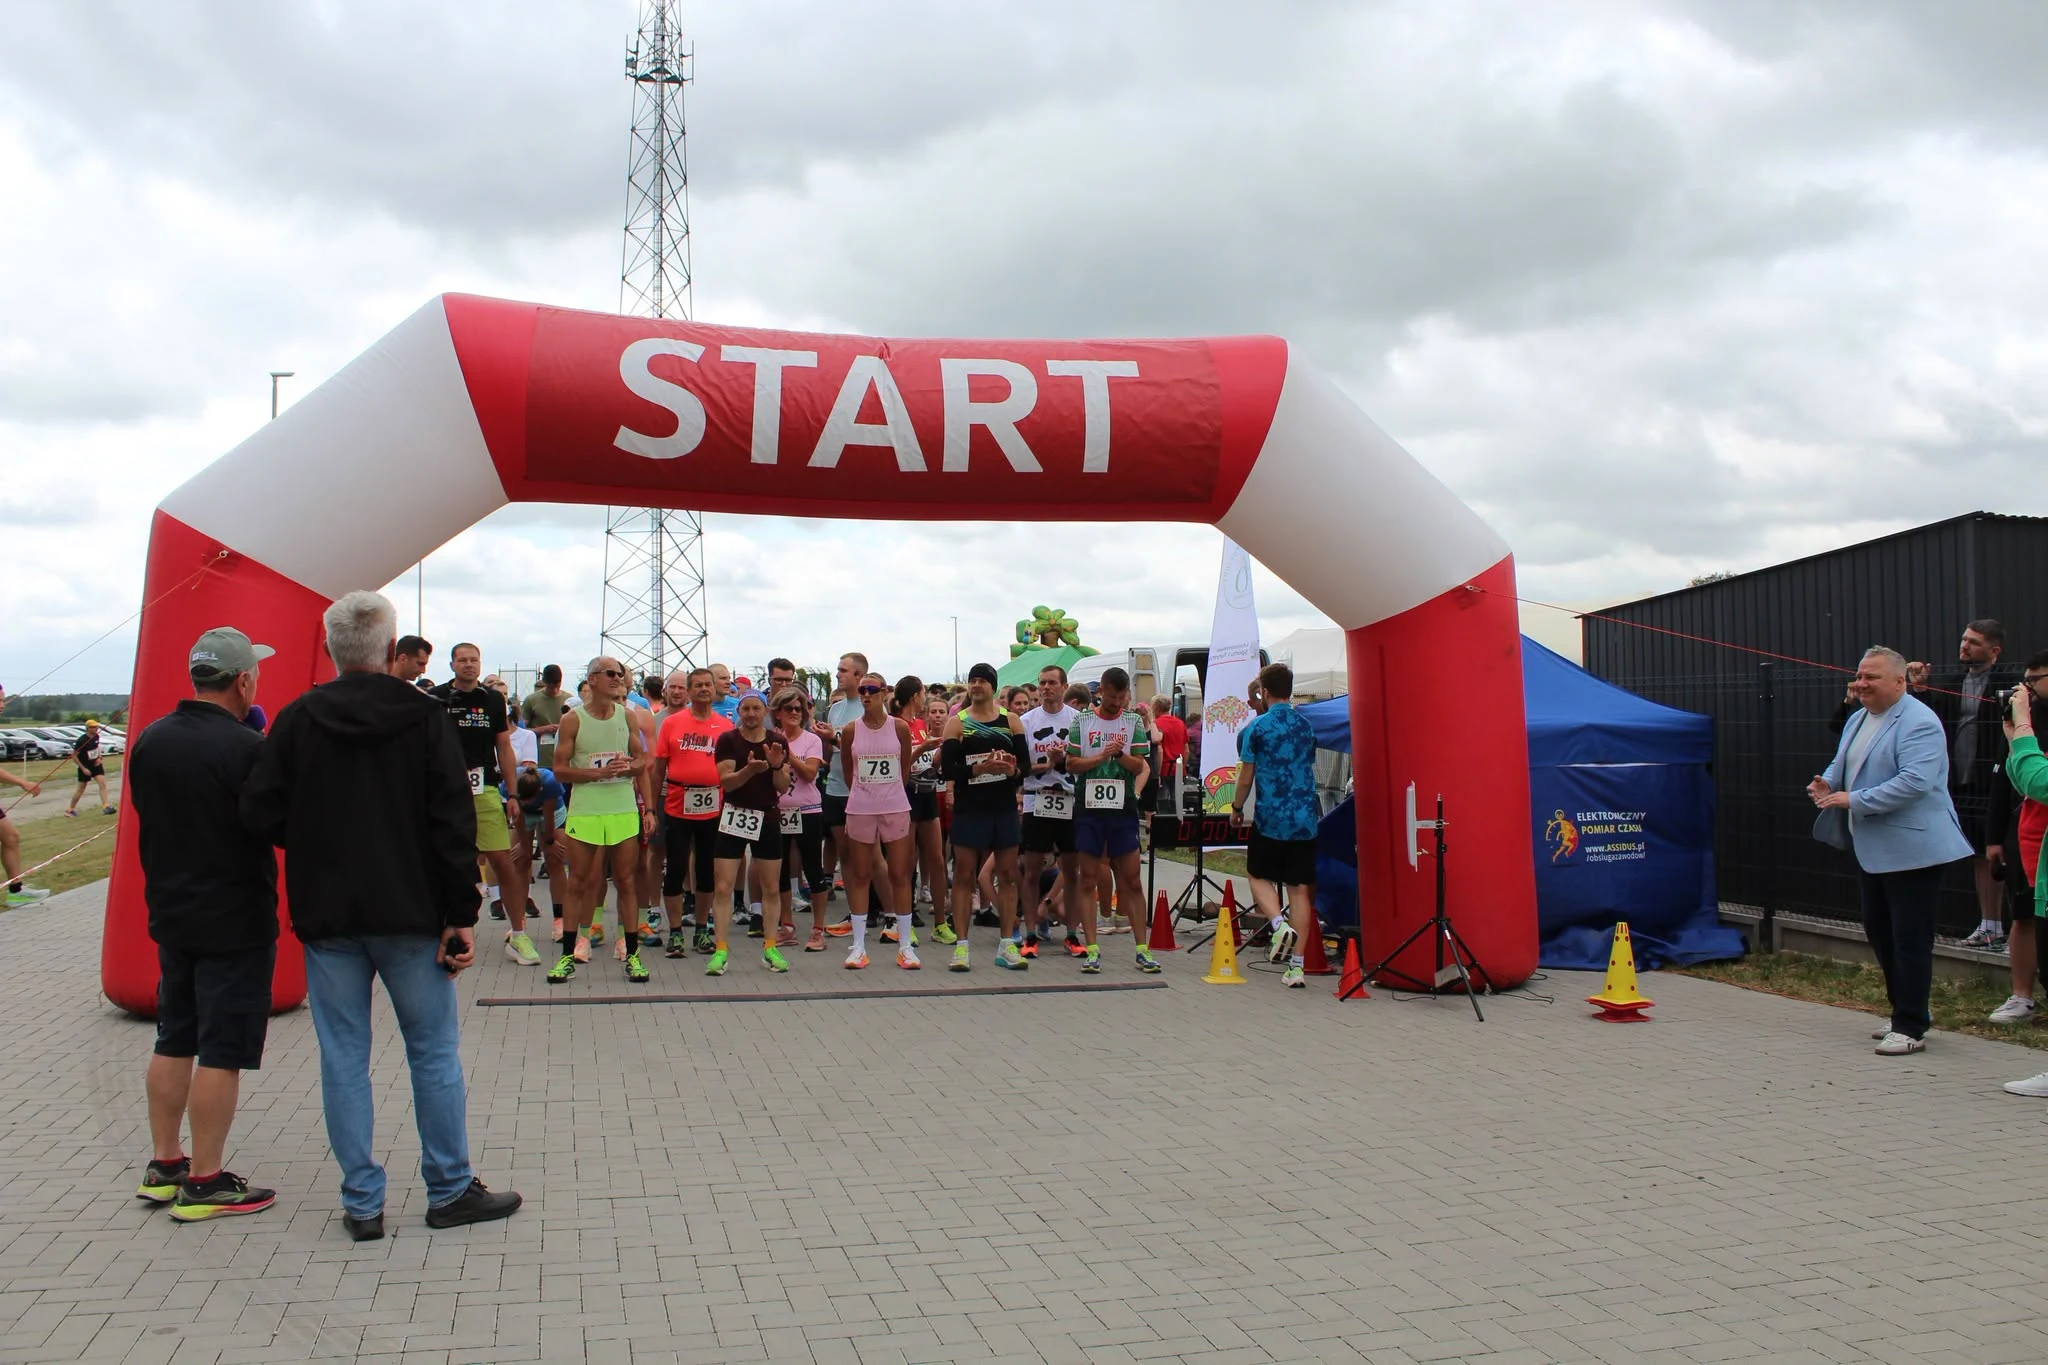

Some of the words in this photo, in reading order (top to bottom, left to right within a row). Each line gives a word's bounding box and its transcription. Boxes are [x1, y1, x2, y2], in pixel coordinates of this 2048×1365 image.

[613, 337, 1139, 473] START
[867, 760, 890, 775] 78
[470, 773, 480, 787] 8
[693, 793, 713, 807] 36
[1094, 785, 1117, 800] 80
[1043, 796, 1065, 811] 35
[727, 811, 759, 831] 133
[780, 812, 799, 827] 64
[1581, 825, 1616, 835] POMIAR
[1617, 823, 1642, 833] CZASU
[1585, 842, 1645, 853] www.ASSIDUS.pl
